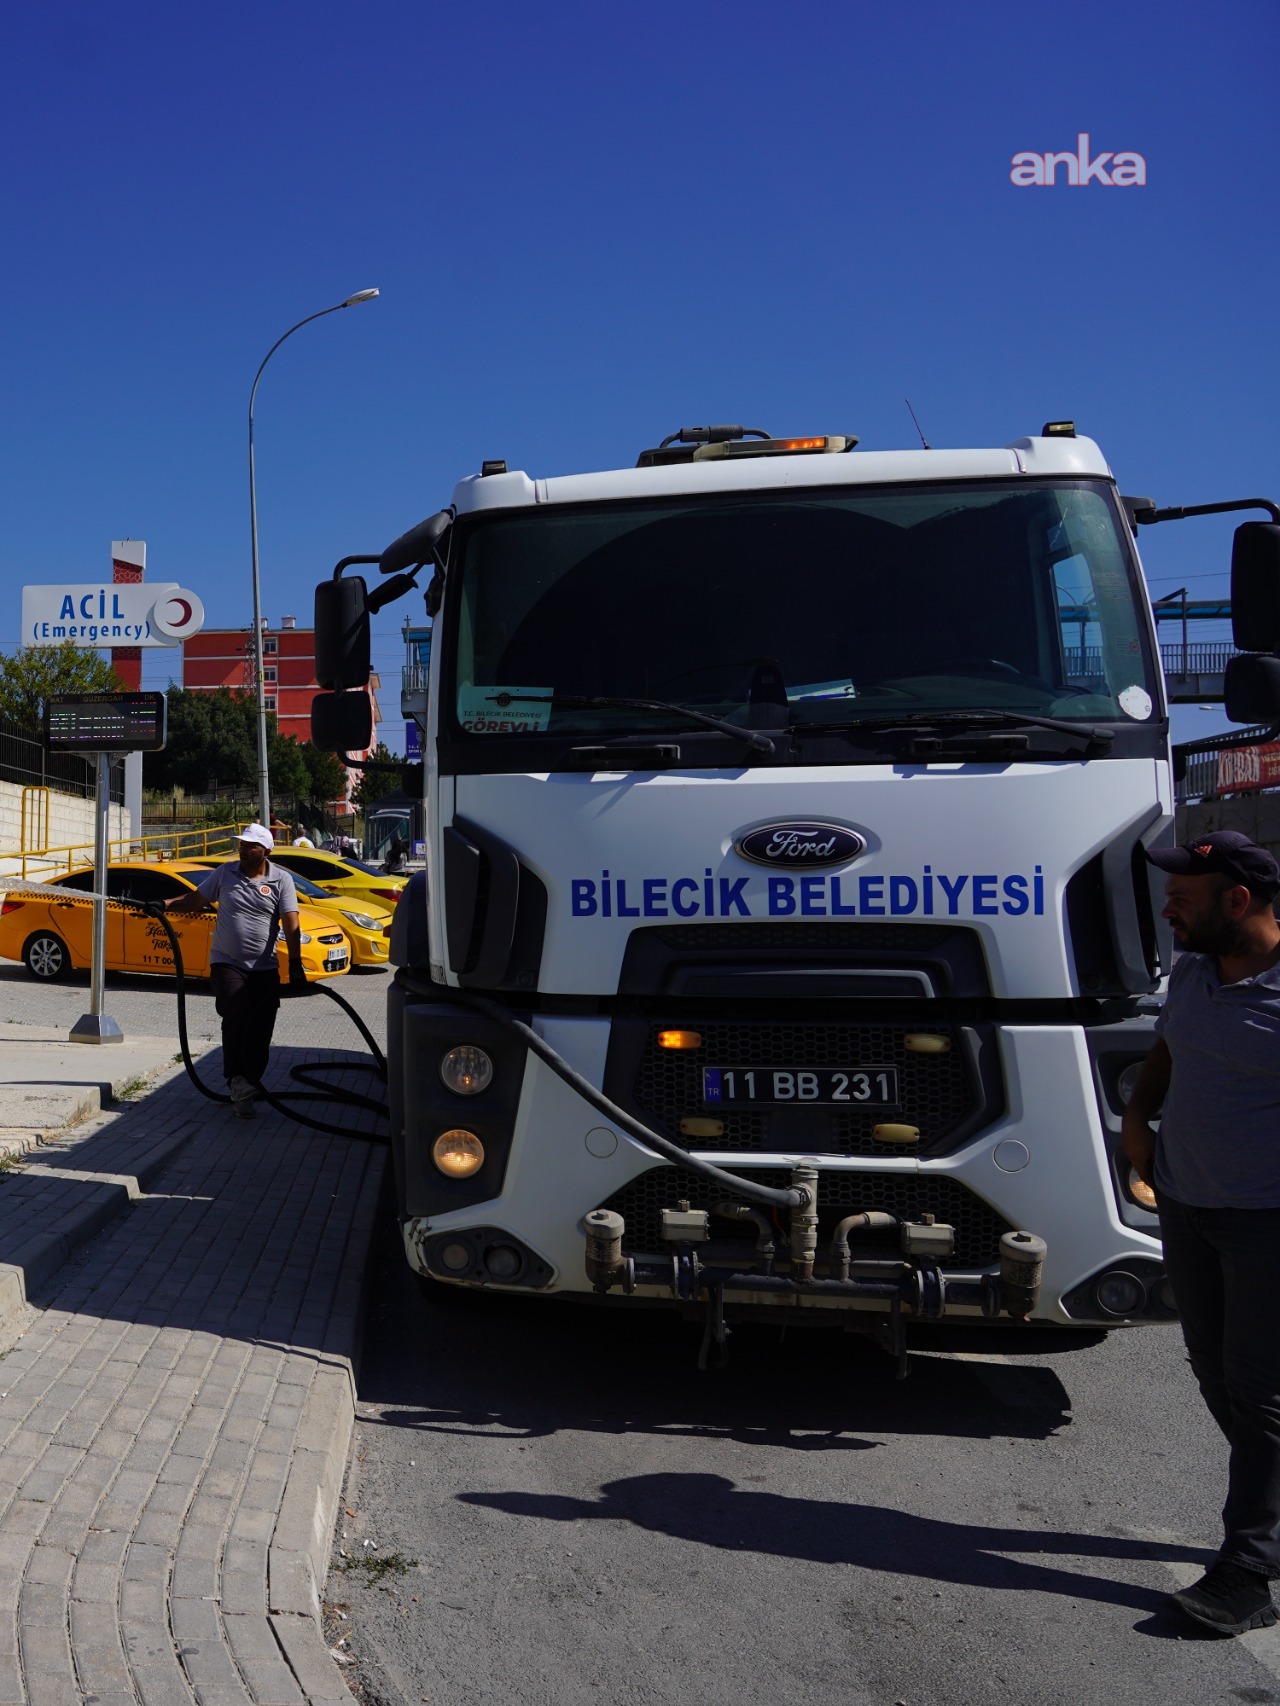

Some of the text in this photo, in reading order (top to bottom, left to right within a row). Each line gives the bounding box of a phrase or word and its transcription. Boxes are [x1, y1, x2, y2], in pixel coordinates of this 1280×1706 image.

[60, 589, 124, 619] ACİL
[33, 621, 150, 640] (Emergency)
[461, 717, 539, 732] GÖREVLİ
[765, 830, 837, 857] Ford
[571, 864, 1045, 918] BİLECİK BELEDİYESİ
[708, 1071, 888, 1101] TR 11 BB 231
